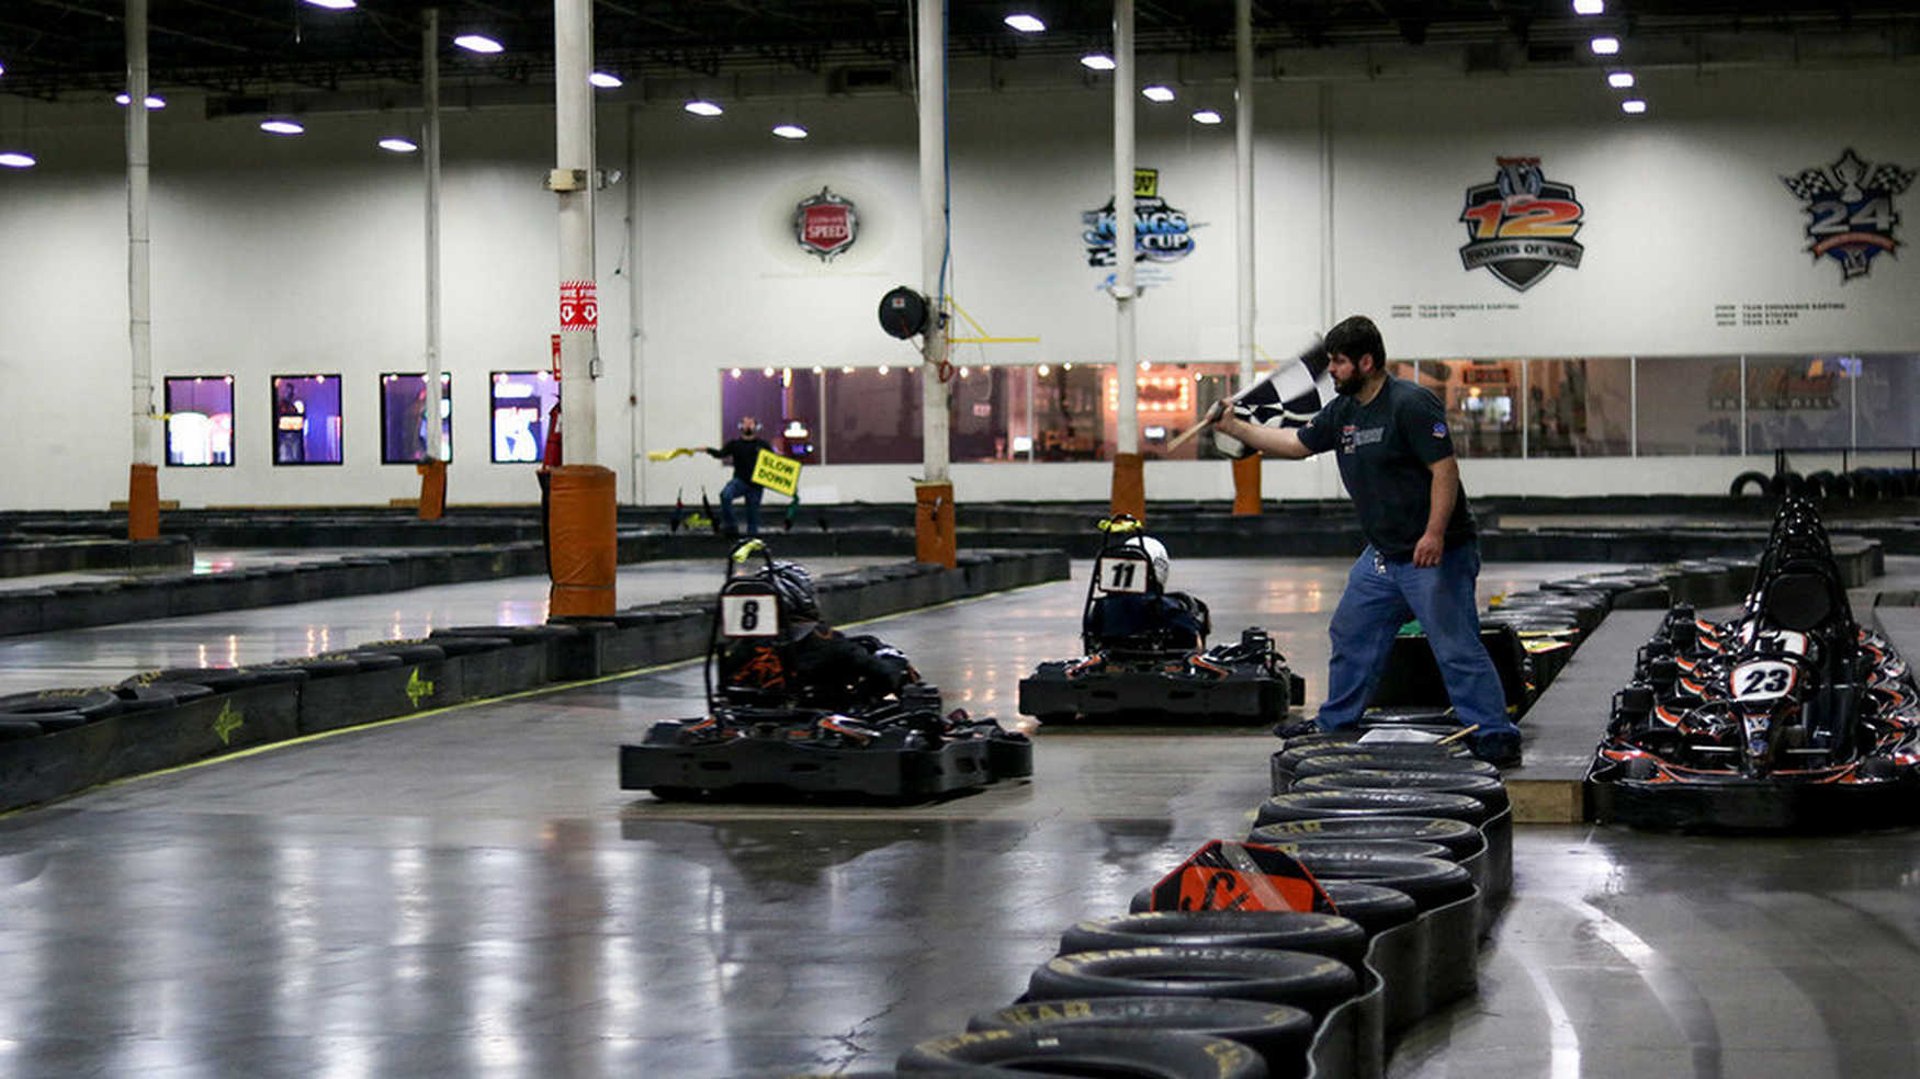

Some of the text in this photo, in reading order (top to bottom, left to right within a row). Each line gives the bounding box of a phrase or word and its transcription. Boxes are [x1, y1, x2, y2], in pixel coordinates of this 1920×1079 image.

[1463, 200, 1582, 238] 12
[1810, 199, 1895, 234] 24
[807, 226, 848, 239] SPEED
[1143, 234, 1188, 248] CUP
[1466, 244, 1519, 262] HOURS
[1524, 244, 1543, 255] OF
[763, 455, 795, 475] SLOW
[758, 468, 792, 488] DOWN
[1112, 563, 1136, 588] 11
[741, 600, 759, 631] 8
[1741, 669, 1789, 695] 23
